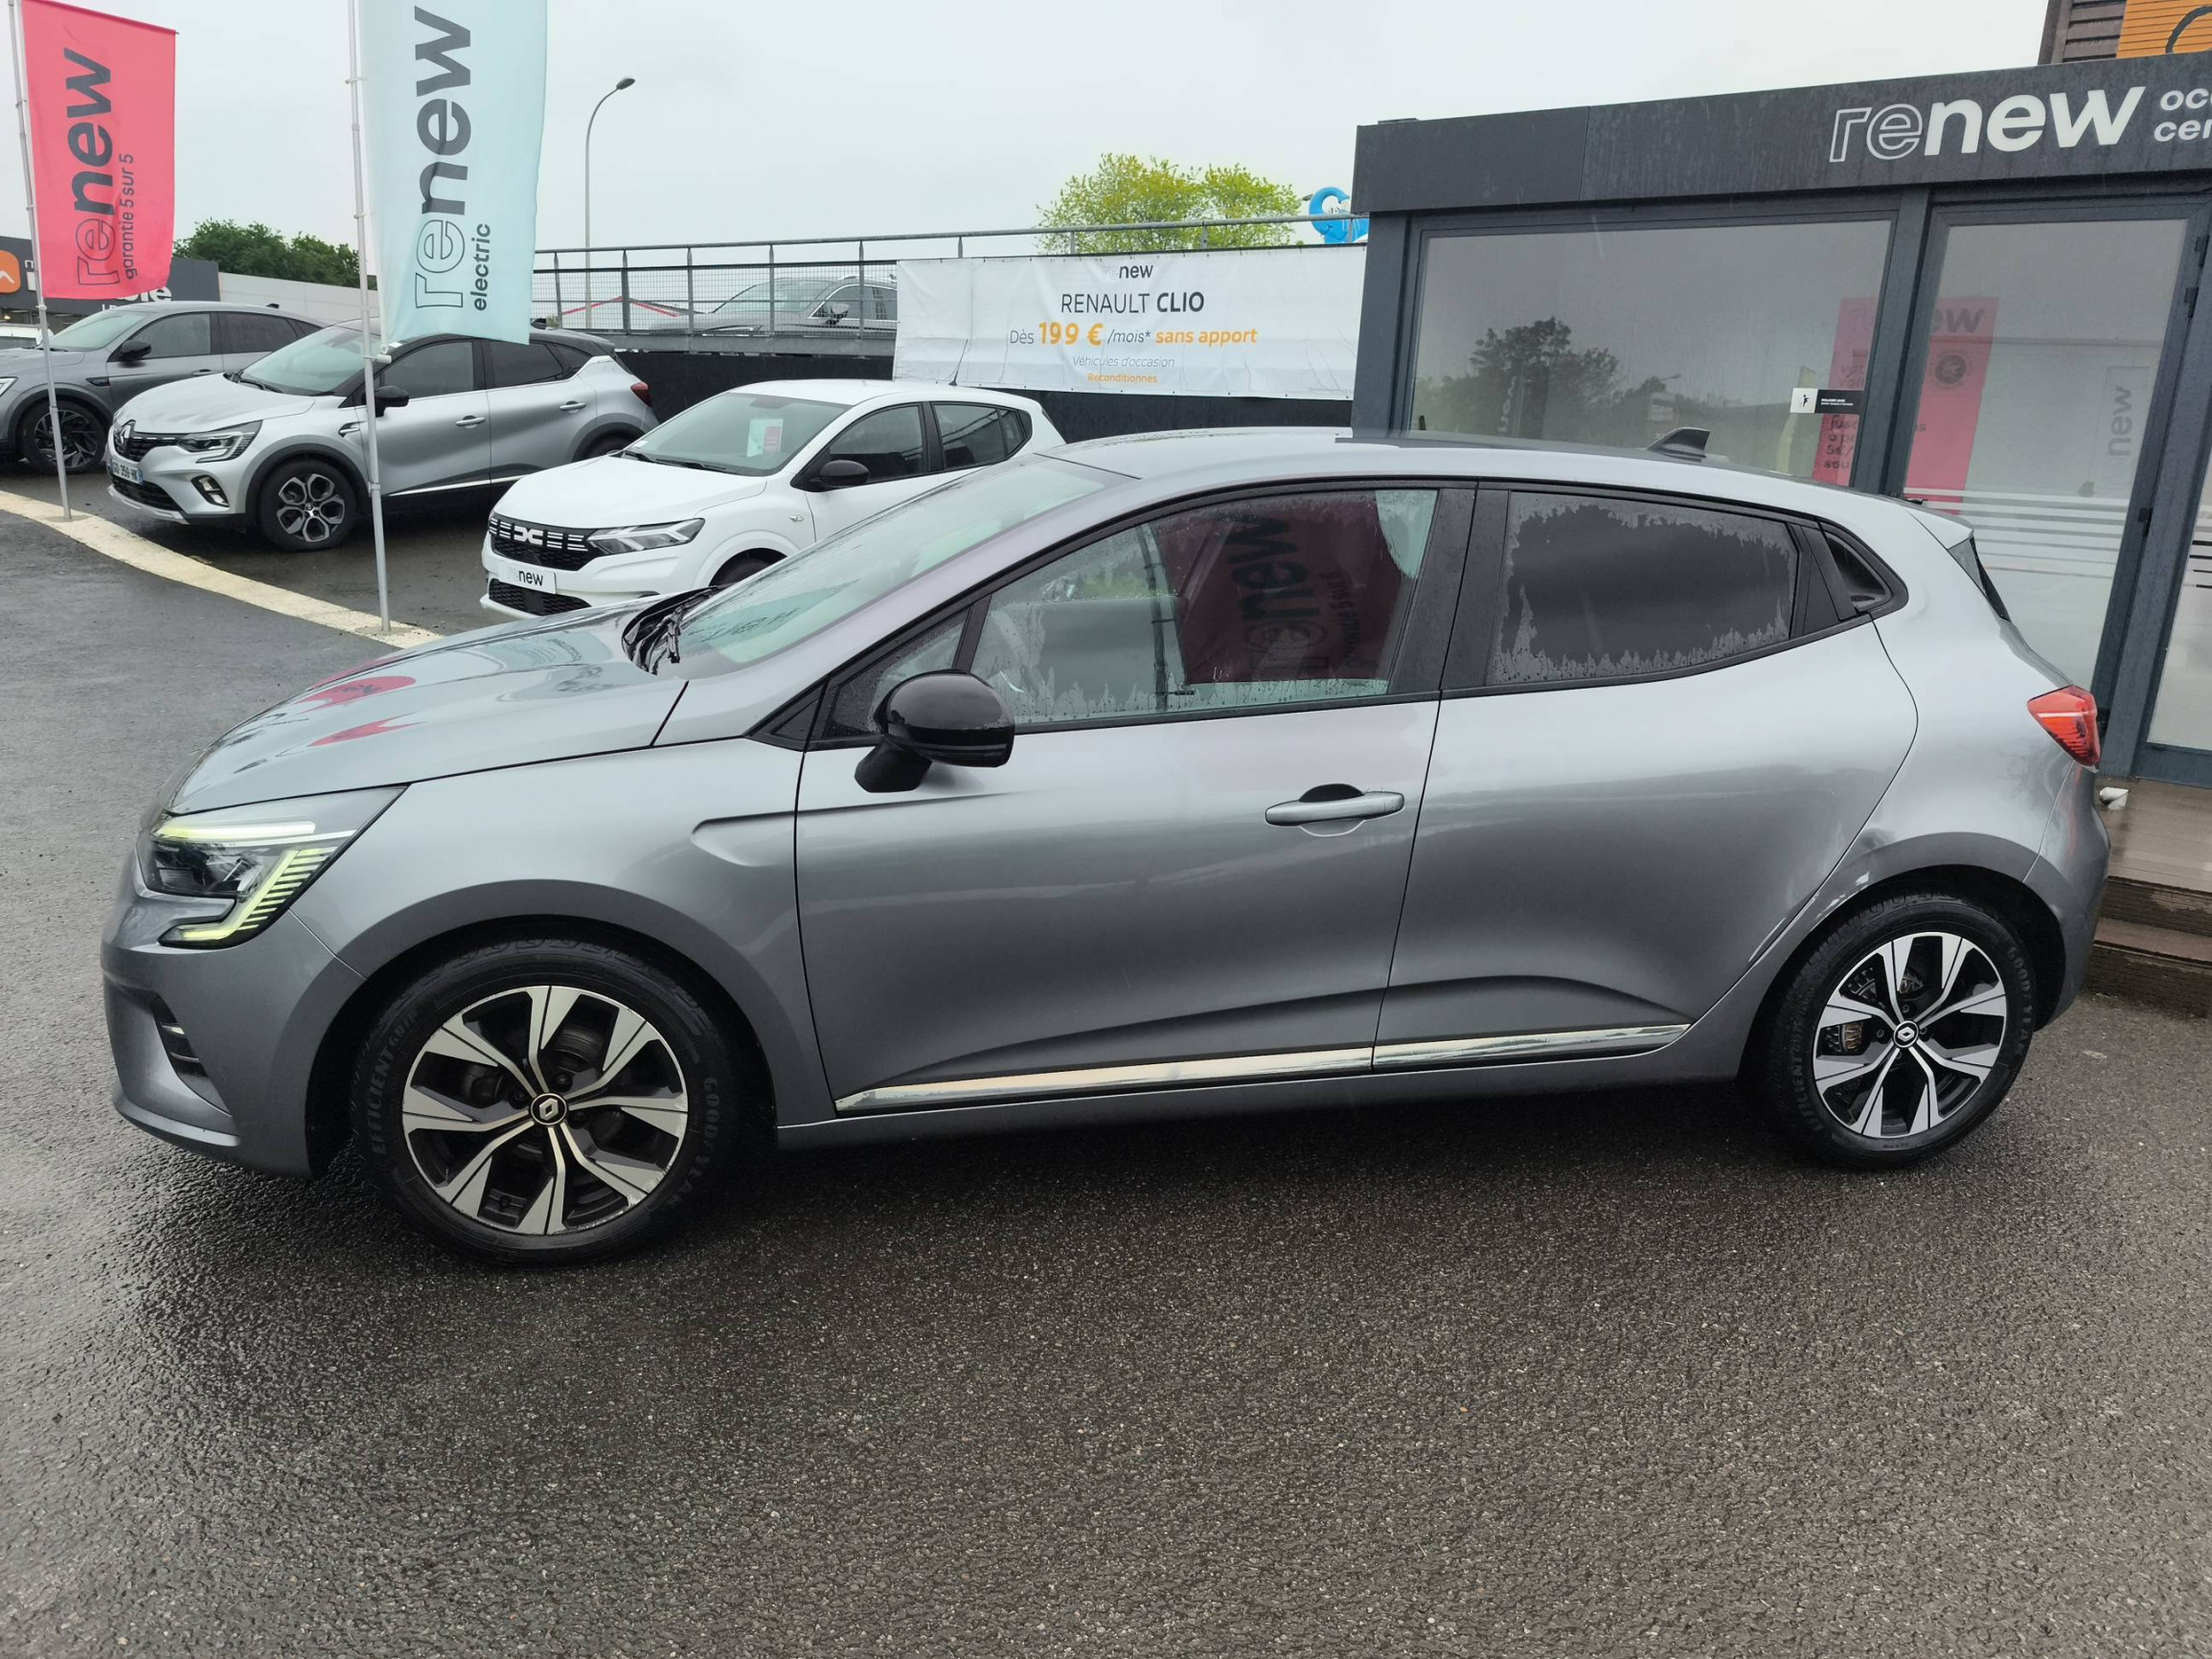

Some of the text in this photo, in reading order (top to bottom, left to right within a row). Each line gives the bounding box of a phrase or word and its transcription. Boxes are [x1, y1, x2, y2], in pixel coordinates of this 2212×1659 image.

[62, 47, 122, 286] renew
[414, 5, 471, 309] renew
[1829, 85, 2146, 163] renew
[119, 153, 138, 281] garantie 5 sur 5
[474, 222, 491, 311] electric
[1060, 290, 1205, 314] RENAULT CLIO
[1009, 329, 1035, 344] Dès
[1038, 321, 1080, 346] 199
[1086, 322, 1105, 346] €
[1155, 330, 1195, 344] sans
[1197, 328, 1258, 347] apport
